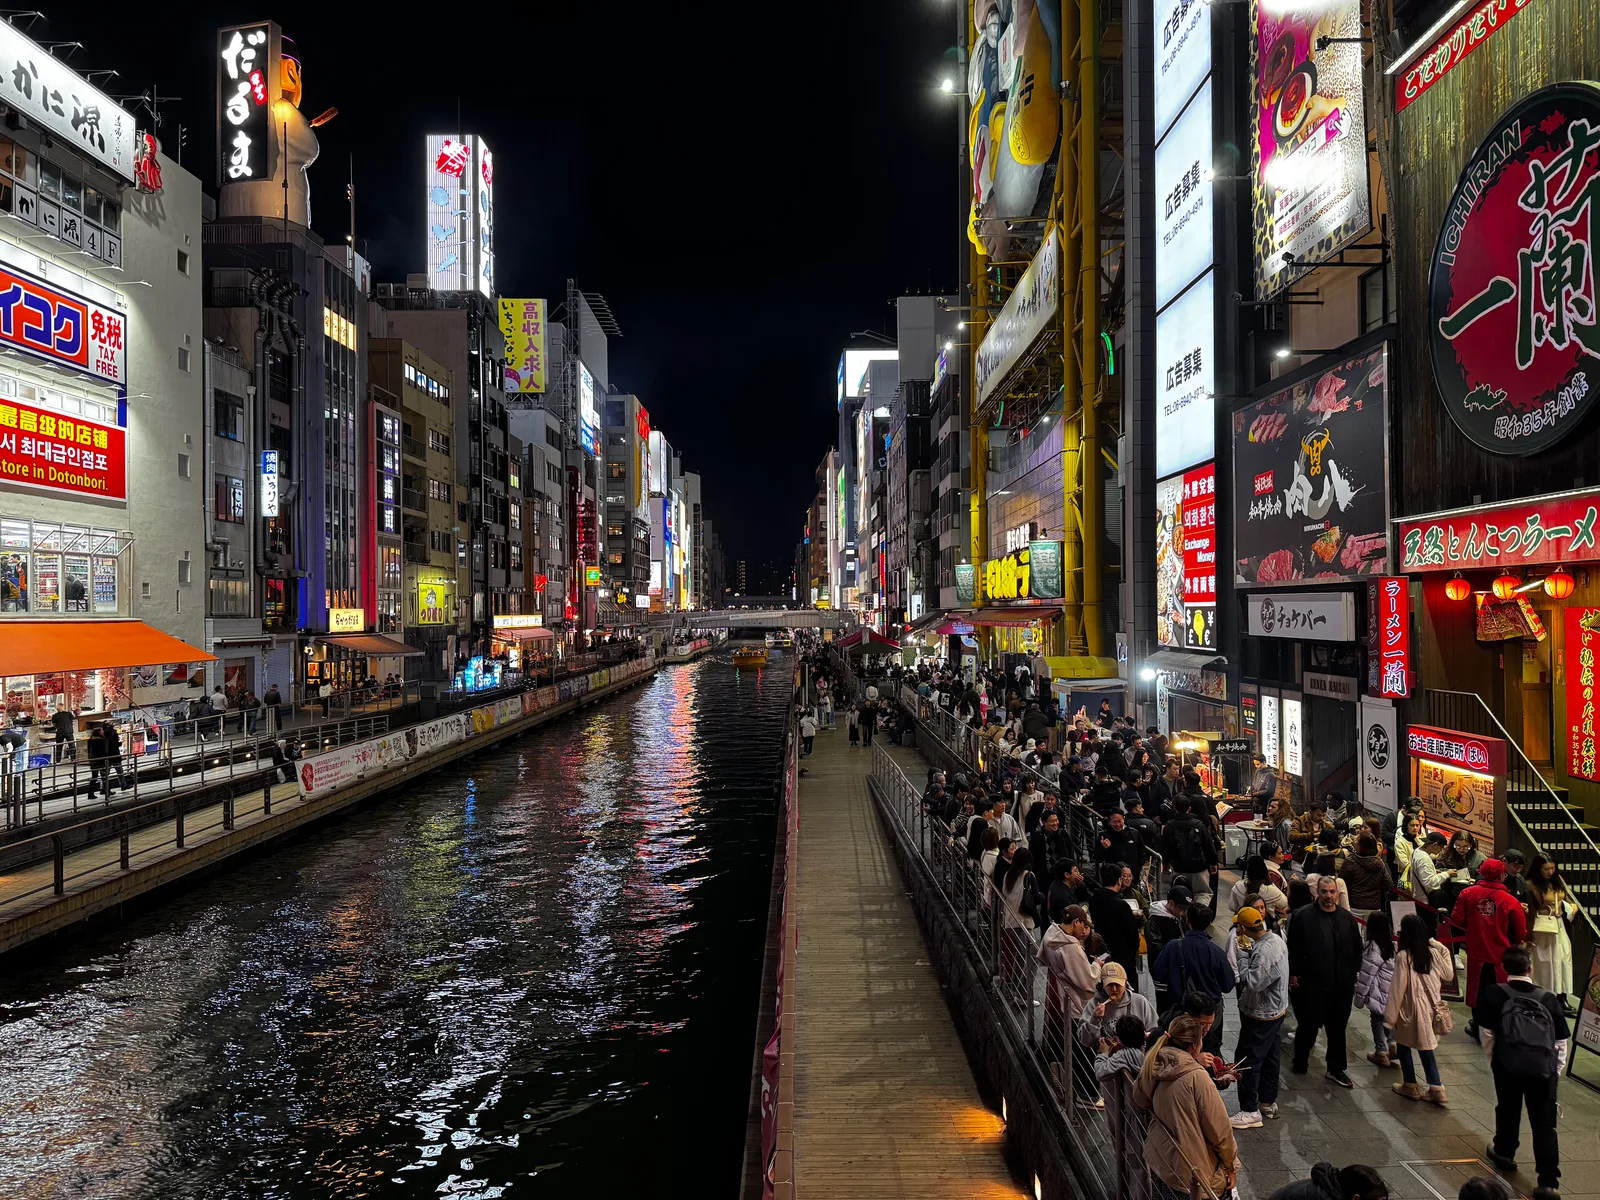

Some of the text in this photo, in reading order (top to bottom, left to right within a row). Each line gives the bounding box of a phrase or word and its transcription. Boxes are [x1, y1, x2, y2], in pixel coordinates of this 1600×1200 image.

[1404, 0, 1528, 98] こだわりたい
[222, 31, 266, 178] だるま
[1165, 160, 1200, 221] 広告募集
[1440, 119, 1522, 267] ICHIRAN
[1439, 118, 1600, 372] 一蘭
[91, 309, 122, 351] 免税
[522, 301, 541, 390] 高収入求人
[95, 357, 118, 379] FREE
[99, 345, 116, 364] TAX
[1166, 347, 1202, 392] 広告募集
[1494, 372, 1589, 440] 昭和35年創業
[0, 405, 108, 449] 最高级的店铺
[0, 433, 108, 471] 서 최대급인점포
[265, 453, 277, 473] 焼肉
[0, 458, 109, 491] tore in Dotonbori.
[266, 475, 277, 515] いろりや
[1248, 495, 1282, 521] 和牛焼肉
[1184, 504, 1215, 530] 외화환전
[1404, 506, 1598, 567] 天然とんこつラーメ
[1184, 536, 1210, 550] Exchange
[1197, 550, 1215, 564] Money
[1277, 606, 1326, 630] チョケバー
[1384, 580, 1407, 695] ラーメン一蘭
[1408, 733, 1487, 763] お土産販売所 はい
[1367, 774, 1391, 788] チョケバー
